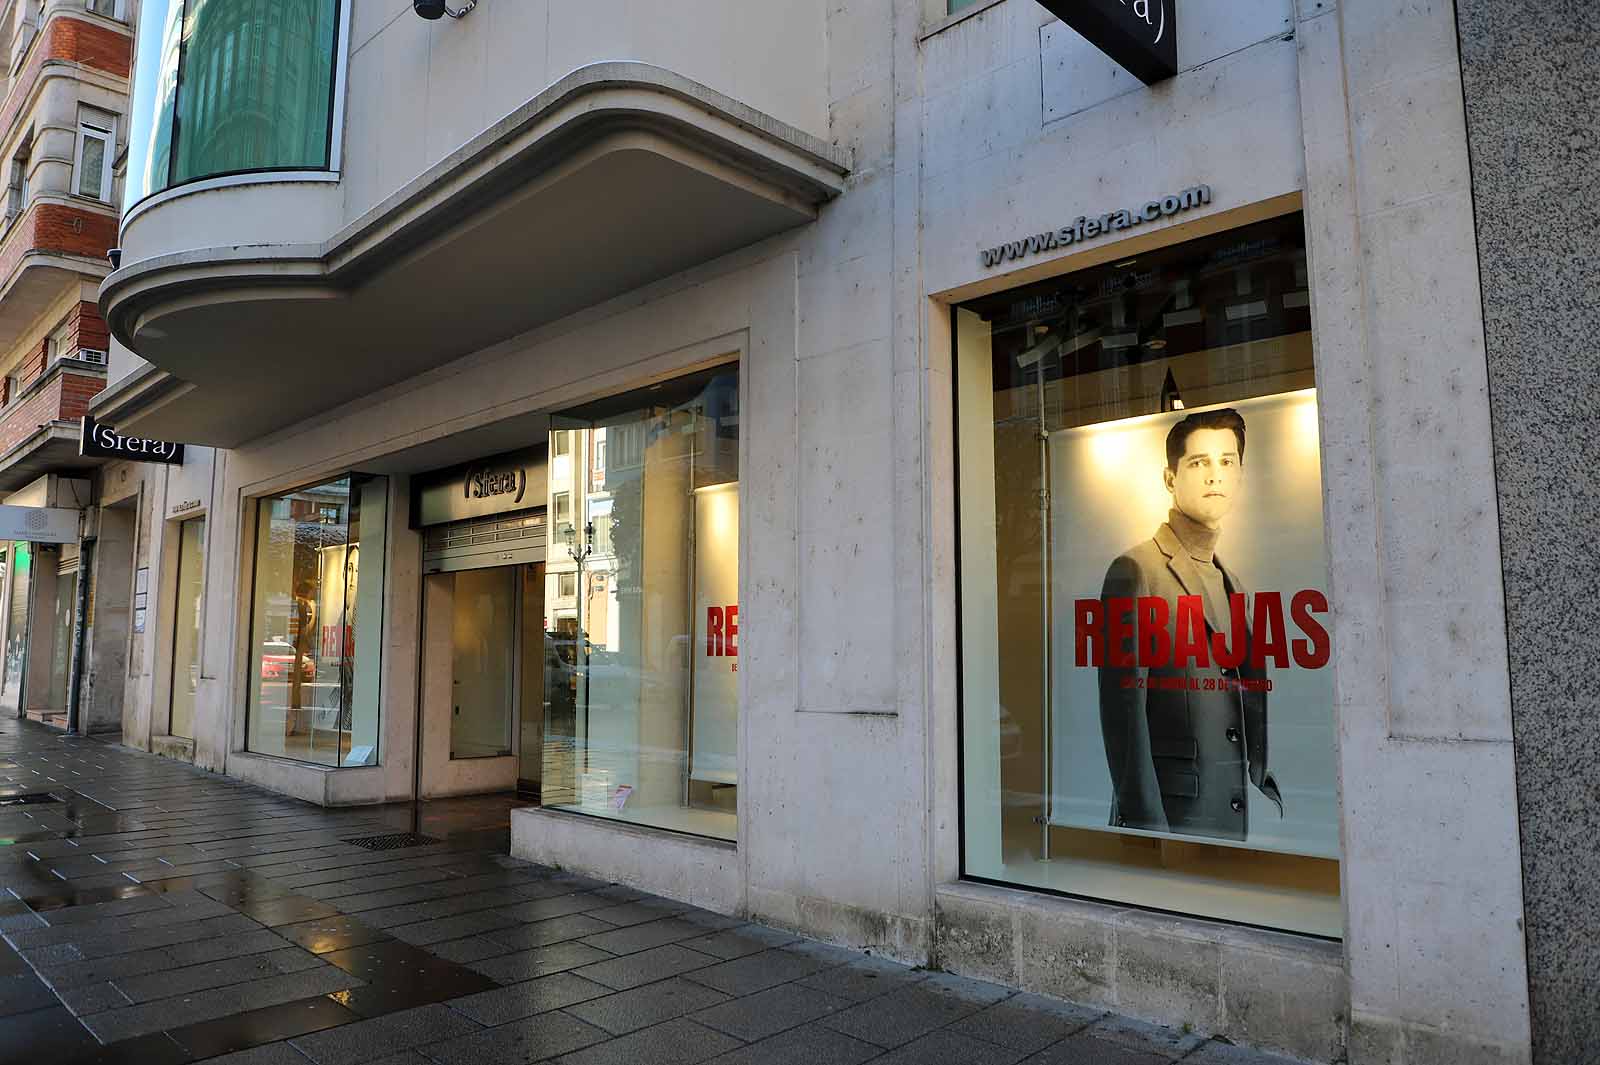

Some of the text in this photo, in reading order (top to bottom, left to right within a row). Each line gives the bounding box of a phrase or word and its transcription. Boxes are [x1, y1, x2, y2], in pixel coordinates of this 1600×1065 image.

[980, 184, 1212, 267] www.sfera.com
[706, 606, 738, 657] RE
[1073, 589, 1332, 670] REBAJAS
[1203, 678, 1215, 690] 28
